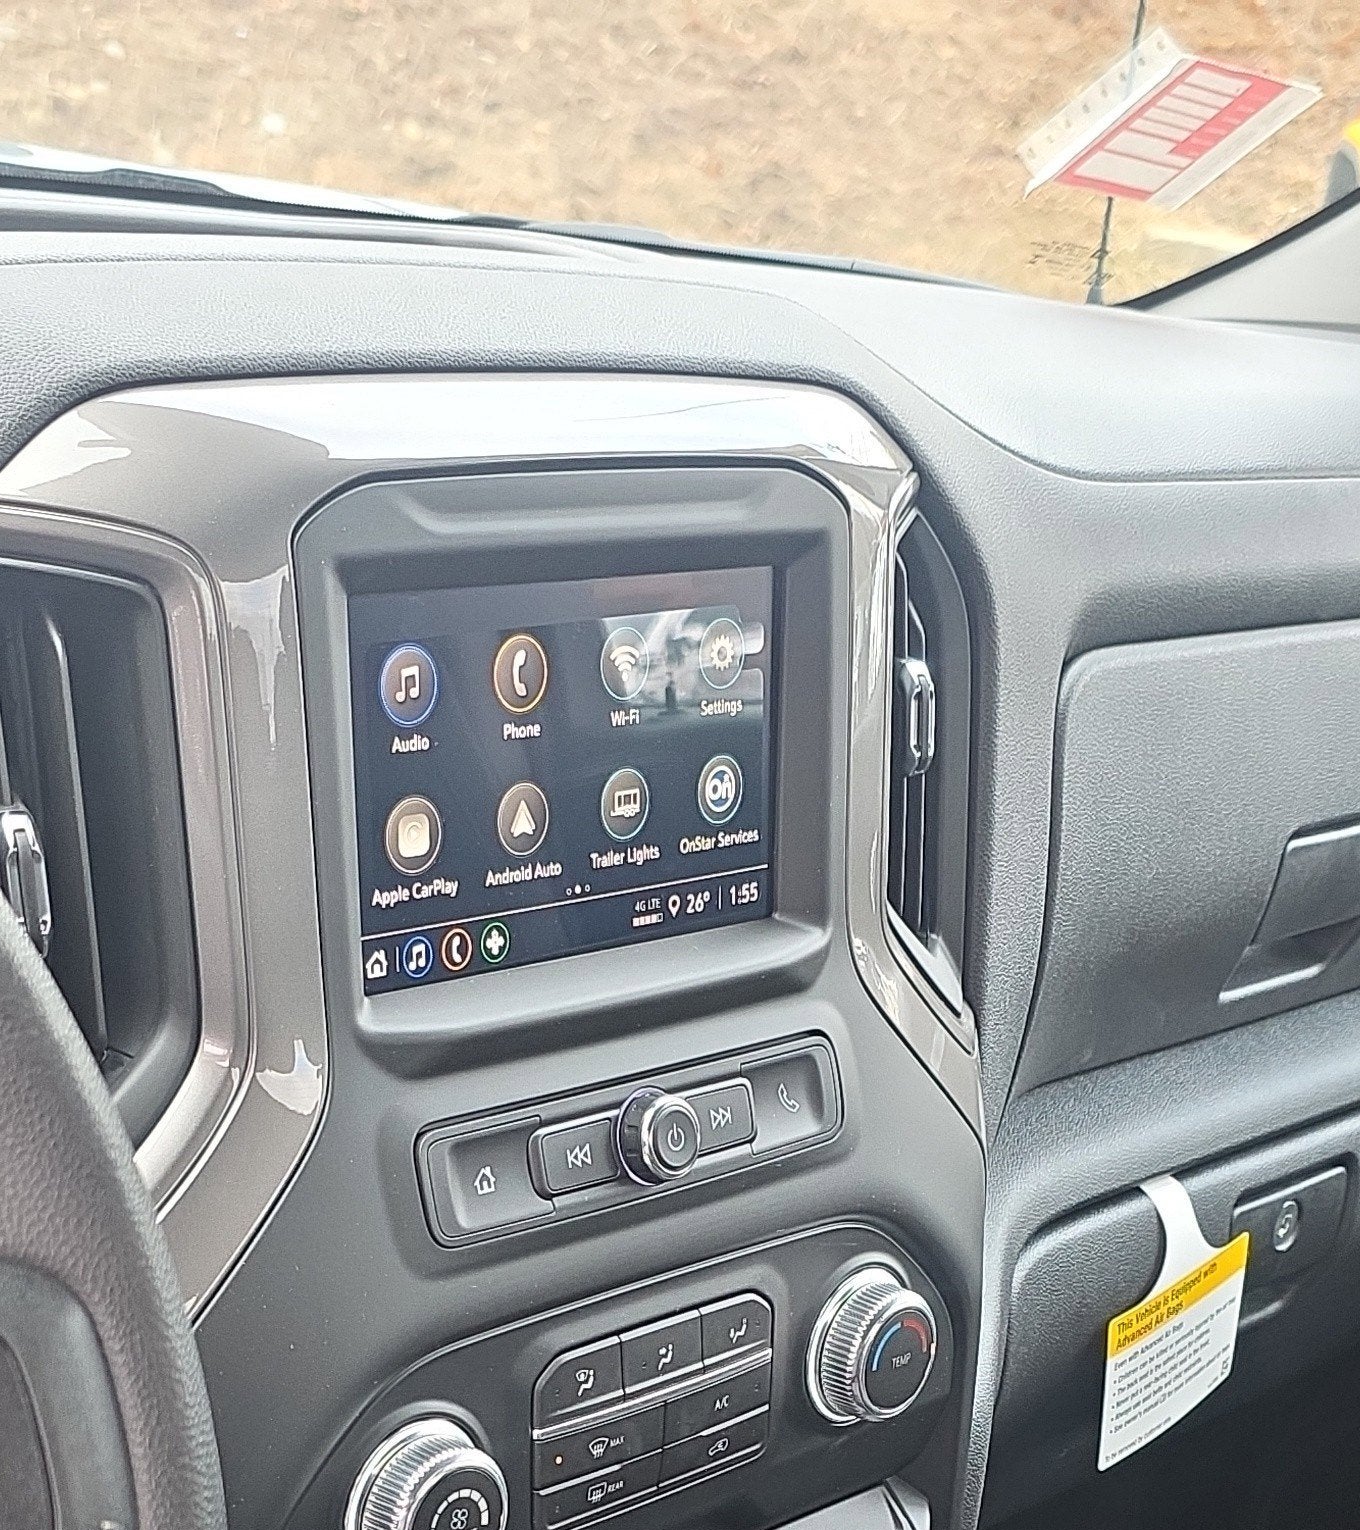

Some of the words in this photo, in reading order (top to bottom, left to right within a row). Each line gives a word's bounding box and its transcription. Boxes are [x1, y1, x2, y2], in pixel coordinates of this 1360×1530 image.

[610, 708, 640, 727] Wi-Fi
[700, 698, 743, 716] Settings
[502, 722, 541, 740] Phone
[391, 733, 430, 753] Audio
[679, 836, 717, 854] OnStar
[717, 828, 760, 848] Services
[590, 849, 626, 870] Trailer
[626, 844, 661, 866] Lights
[485, 863, 533, 888] Android
[533, 860, 563, 879] Auto
[371, 886, 410, 909] Apple
[411, 879, 459, 898] CarPlay
[634, 901, 646, 913] 4G
[647, 898, 661, 910] LTE
[729, 881, 759, 906] 1:55
[1117, 1319, 1133, 1335] This
[1135, 1300, 1162, 1324] Vehicle
[1162, 1295, 1170, 1307] is
[1171, 1270, 1202, 1301] Equipped
[1203, 1262, 1218, 1279] with
[1116, 1318, 1153, 1351] Advanced
[1154, 1312, 1166, 1328] Air
[1166, 1300, 1184, 1319] Bags
[891, 1352, 912, 1370] TEMP
[714, 1394, 730, 1411] A/C
[607, 1480, 624, 1494] REAR
